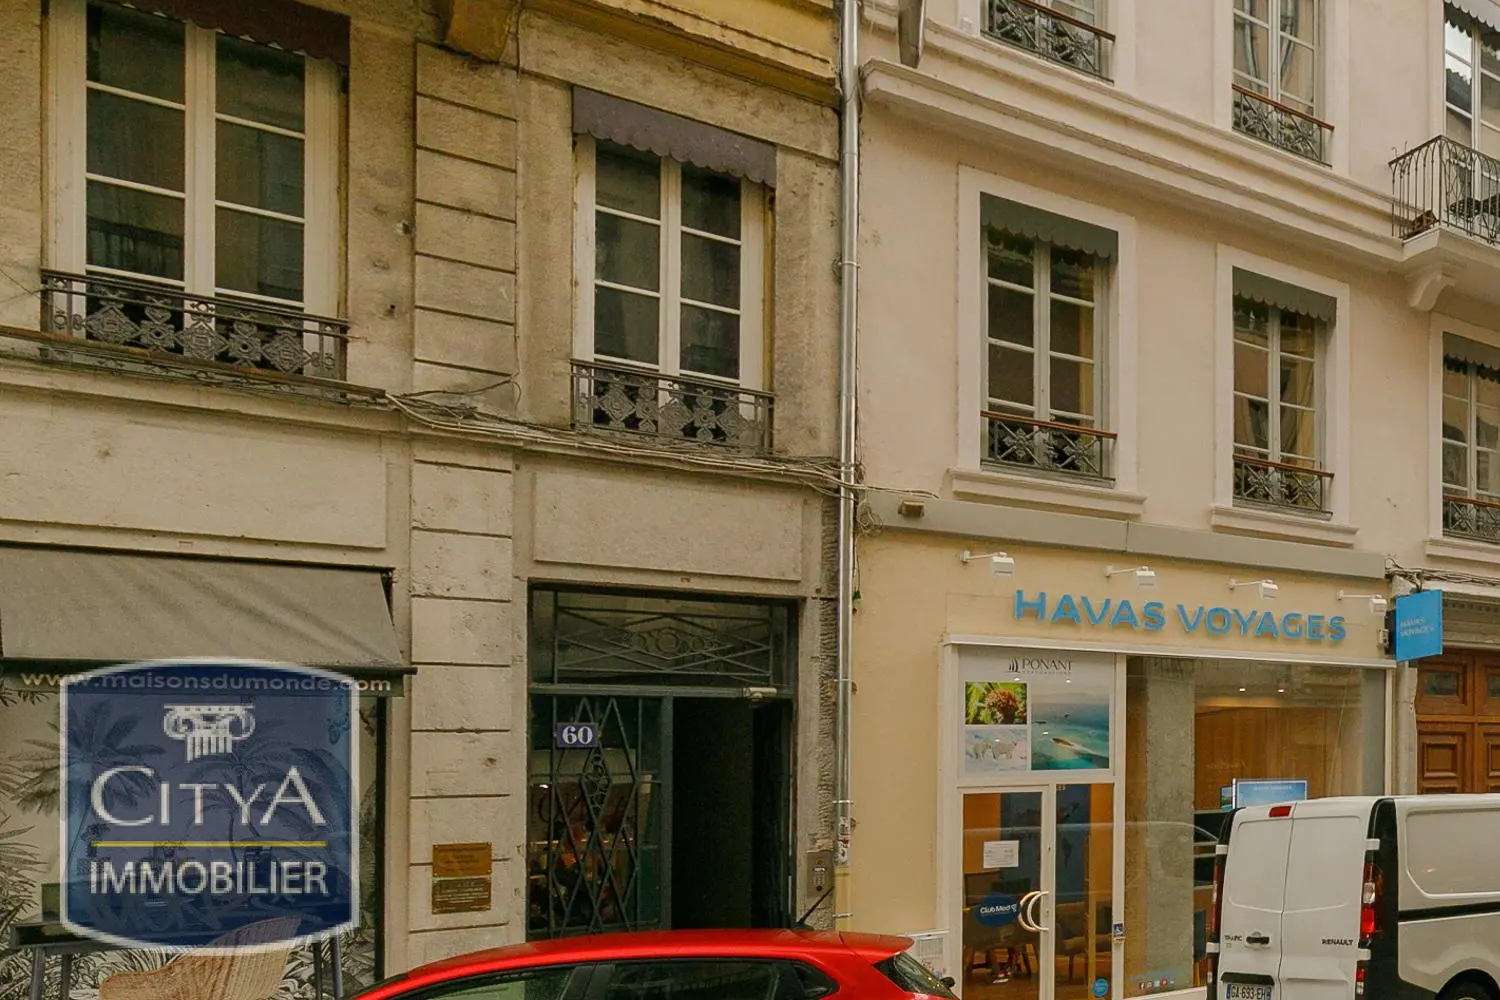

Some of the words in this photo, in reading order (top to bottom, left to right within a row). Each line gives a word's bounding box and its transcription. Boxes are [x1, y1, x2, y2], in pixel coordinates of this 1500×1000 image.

[1014, 589, 1166, 631] HAVAS
[1176, 603, 1347, 642] VOYAGES
[1022, 658, 1073, 671] PONANT
[20, 670, 391, 692] www.maisonsdumonde.com
[562, 726, 593, 744] 60
[980, 905, 995, 914] Club
[995, 904, 1011, 913] Med
[1321, 938, 1354, 946] RENAULT
